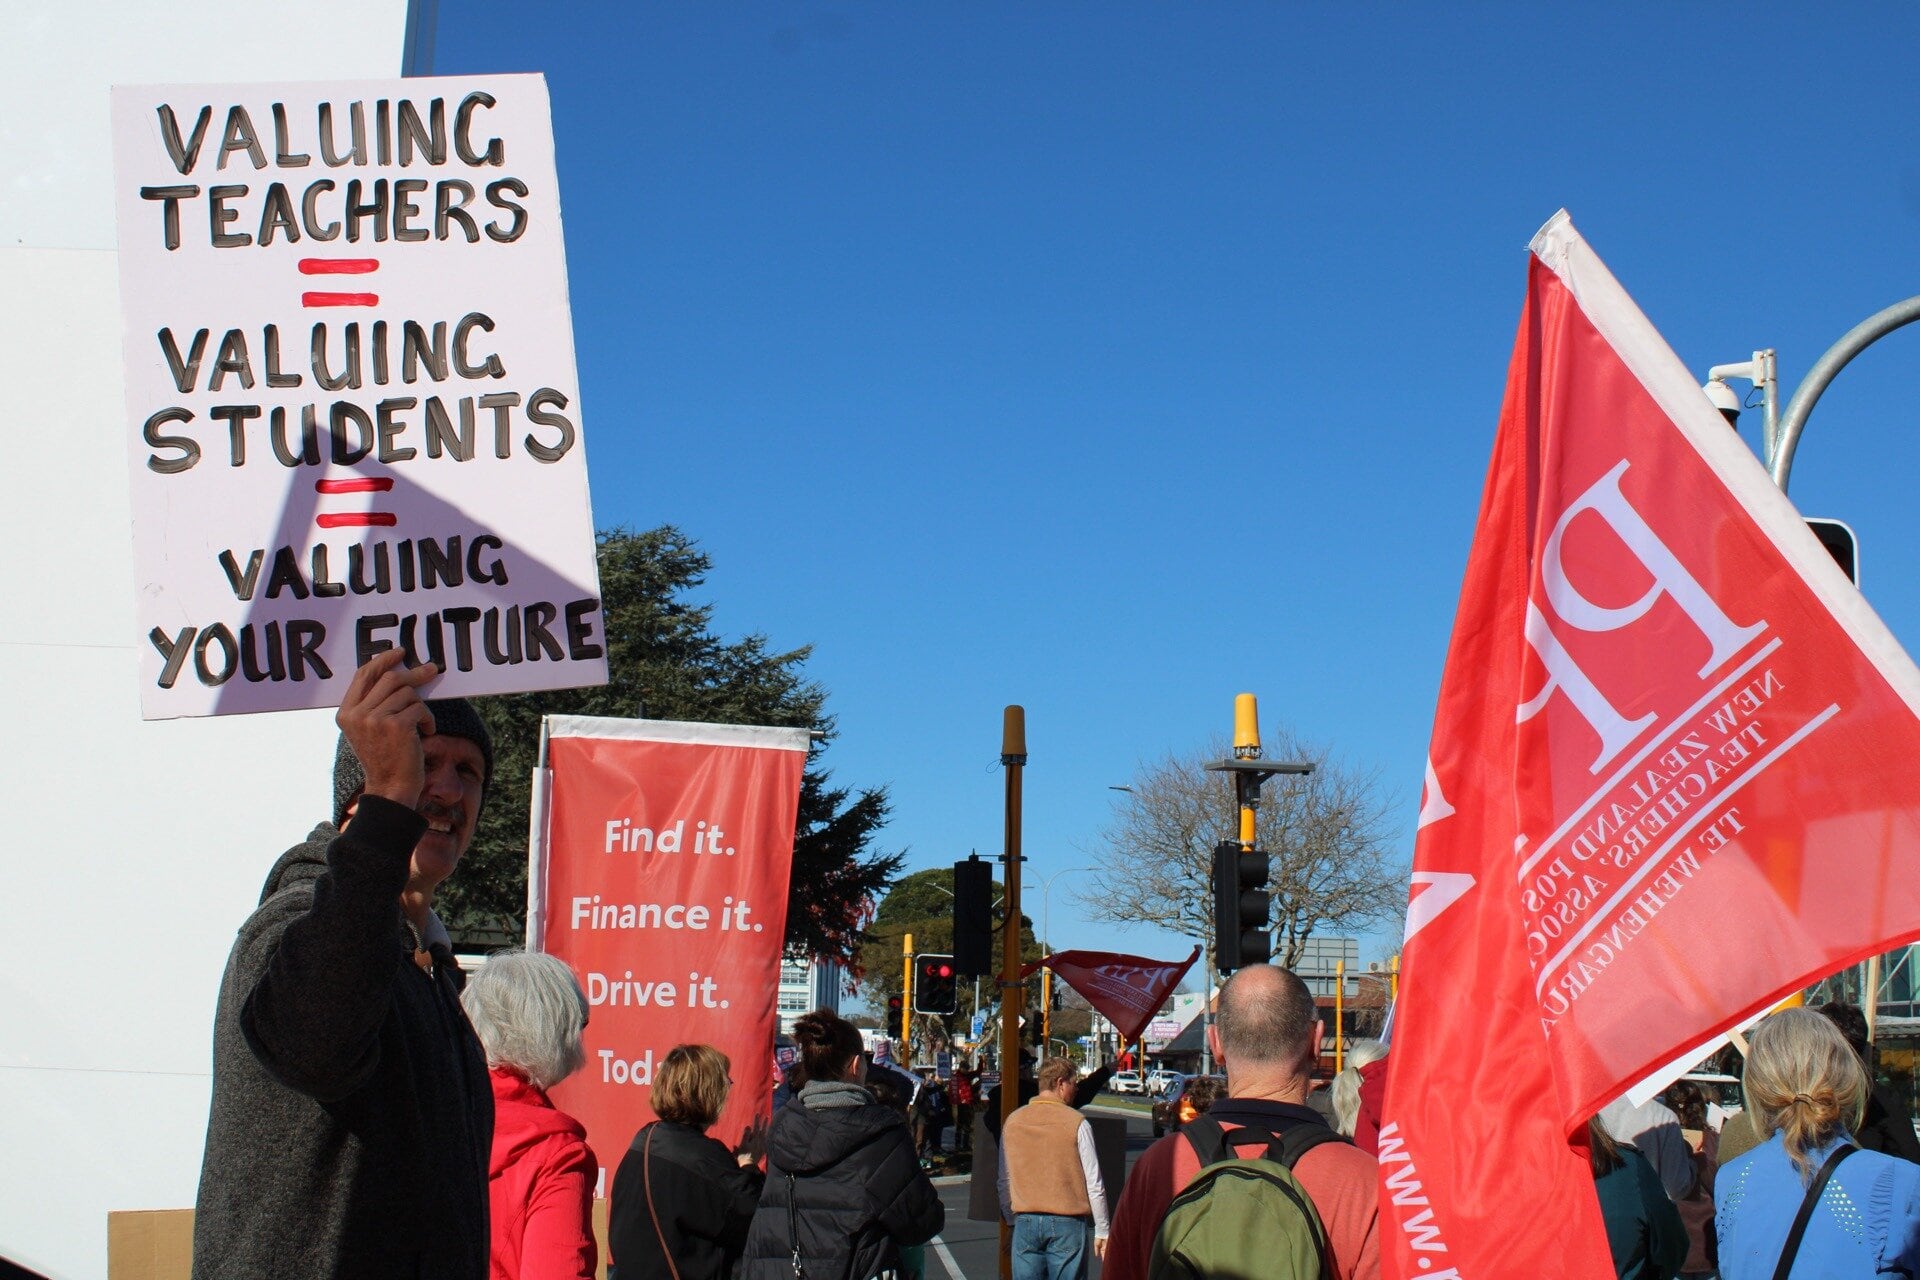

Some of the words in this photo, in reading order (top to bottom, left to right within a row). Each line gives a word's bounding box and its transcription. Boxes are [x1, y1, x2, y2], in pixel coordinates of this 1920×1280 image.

[157, 91, 504, 175] VALUING
[140, 177, 529, 250] TEACHERS
[158, 312, 506, 392] VALUING
[143, 387, 575, 474] STUDENTS
[219, 534, 507, 601] VALUING
[150, 618, 333, 689] YOUR
[357, 598, 603, 673] FUTURE
[605, 818, 684, 854] Find
[693, 820, 735, 856] it.
[571, 895, 709, 931] Finance
[720, 896, 763, 932] it.
[587, 972, 676, 1008] Drive
[688, 972, 729, 1009] it.
[598, 1049, 662, 1085] Tod
[1378, 1121, 1463, 1280] www.
